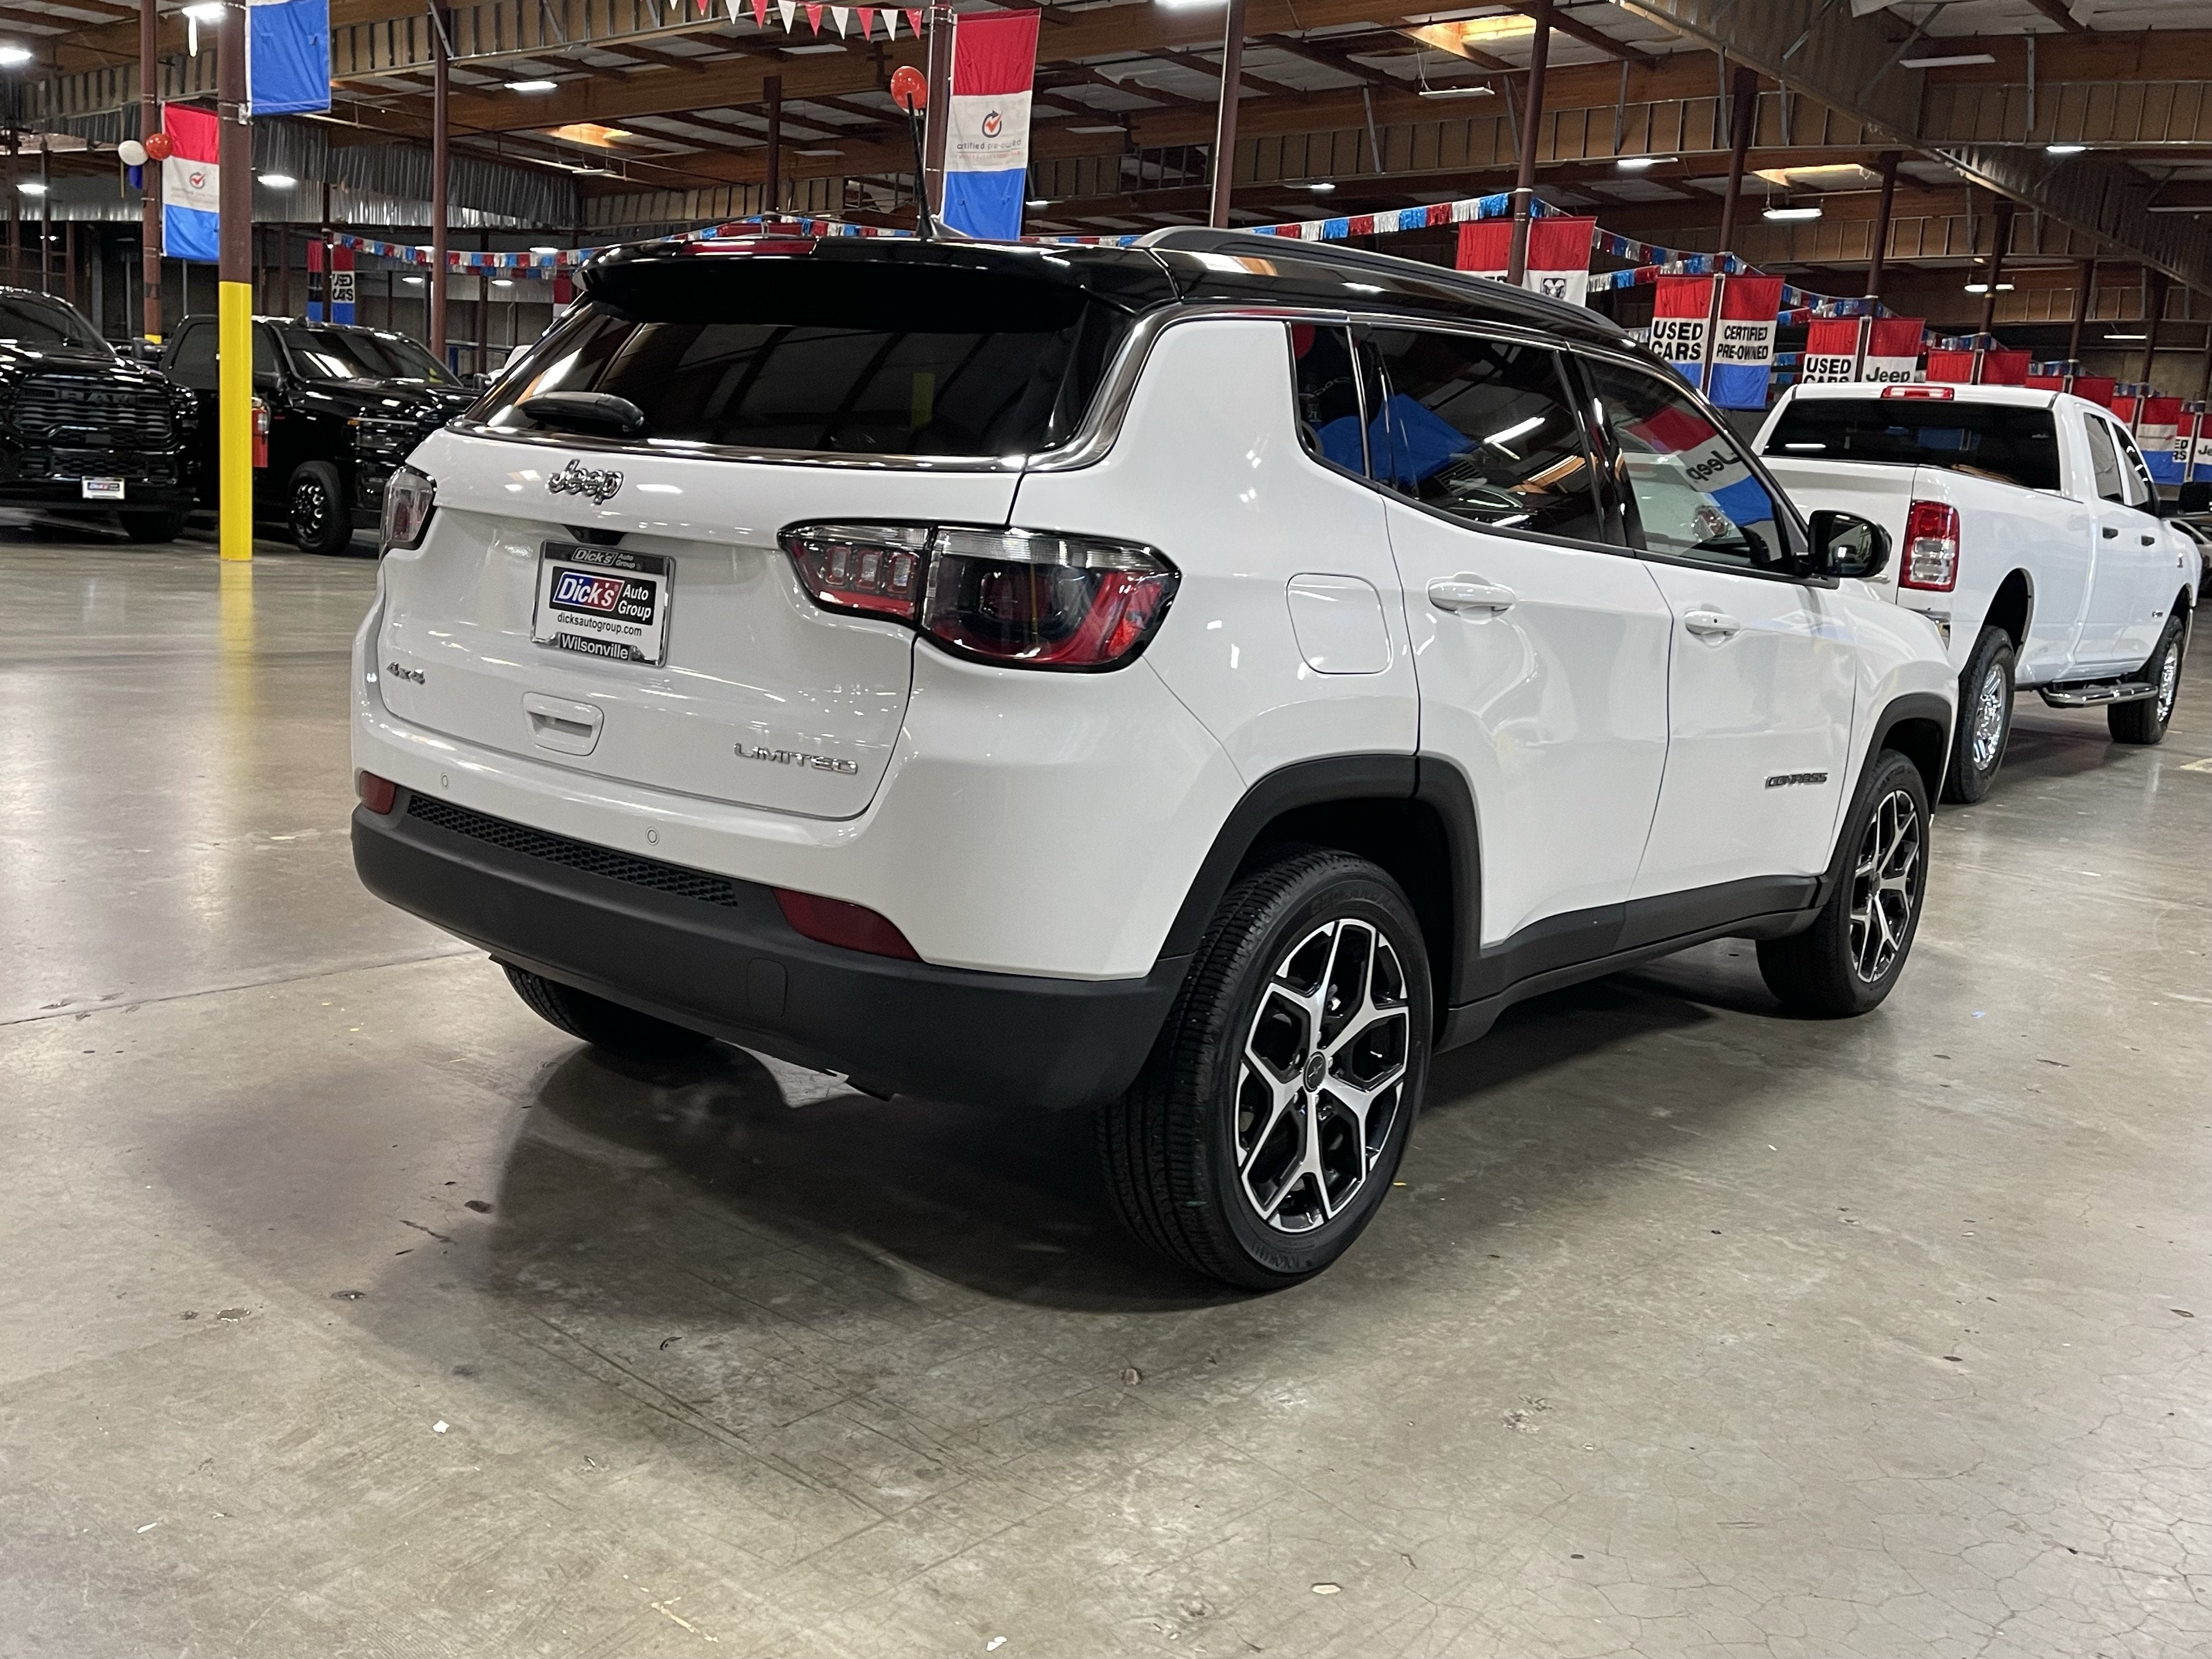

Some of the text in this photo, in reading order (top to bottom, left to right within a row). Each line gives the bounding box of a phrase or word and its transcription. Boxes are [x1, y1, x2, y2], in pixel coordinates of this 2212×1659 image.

[987, 138, 1022, 150] pre-owed
[1653, 320, 1704, 341] USED
[1724, 324, 1768, 342] CERTIFIED
[1650, 341, 1701, 360] CARS
[1716, 345, 1769, 360] PRE-OWNED
[1806, 358, 1852, 374] USED
[1866, 366, 1910, 382] Jeep
[2175, 439, 2188, 449] ED
[2198, 445, 2212, 456] Je
[2172, 451, 2187, 460] RS
[549, 459, 624, 505] Jeep
[574, 549, 613, 564] Dick's
[616, 560, 636, 569] Group
[618, 553, 634, 561] Auto
[557, 578, 615, 607] Dick's
[622, 584, 649, 601] Auto
[618, 600, 652, 622] Group
[557, 613, 642, 637] dicksautogroup.com
[561, 634, 629, 659] Wilsonville
[734, 743, 857, 775] LIMITED
